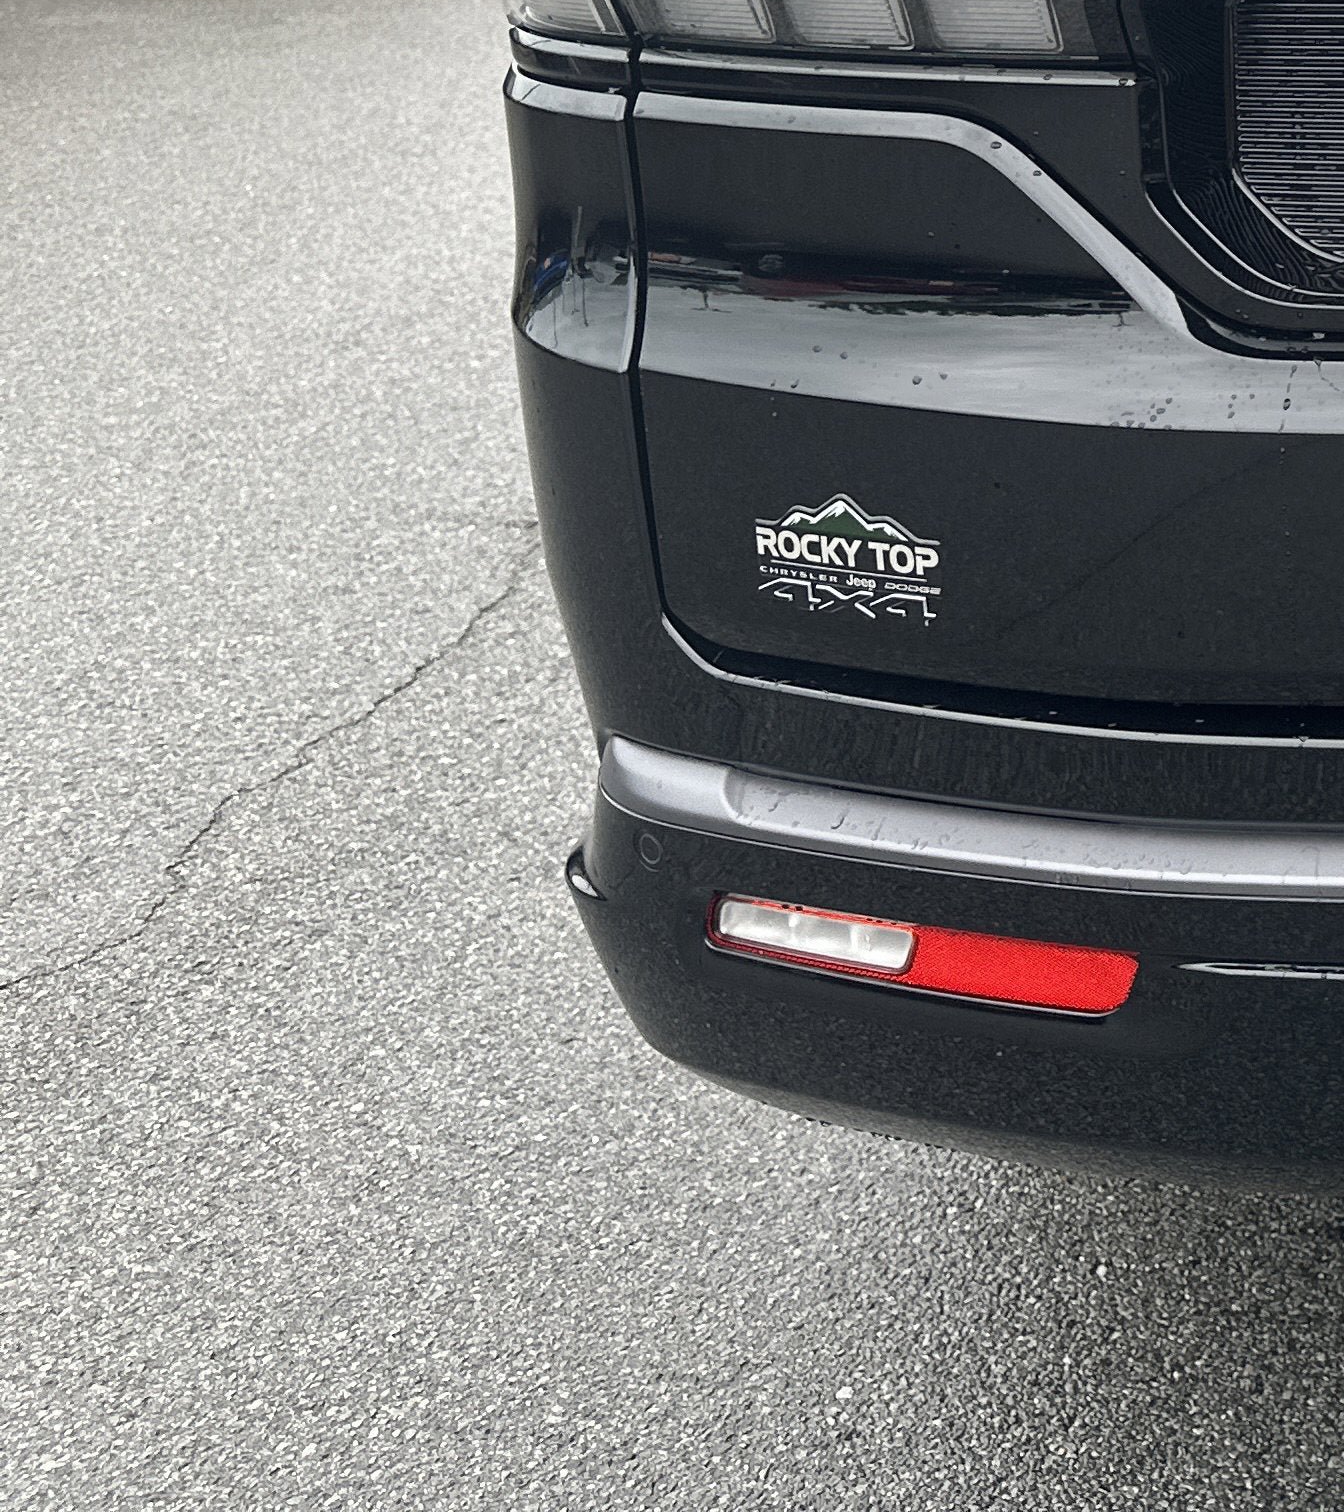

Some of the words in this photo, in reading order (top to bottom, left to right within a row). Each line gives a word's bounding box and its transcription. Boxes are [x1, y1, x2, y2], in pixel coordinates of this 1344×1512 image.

[755, 526, 862, 568] ROCKY
[868, 541, 940, 576] TOP
[760, 565, 838, 583] CHRYSLER
[846, 574, 876, 591] Jeep
[884, 582, 941, 595] DODGE
